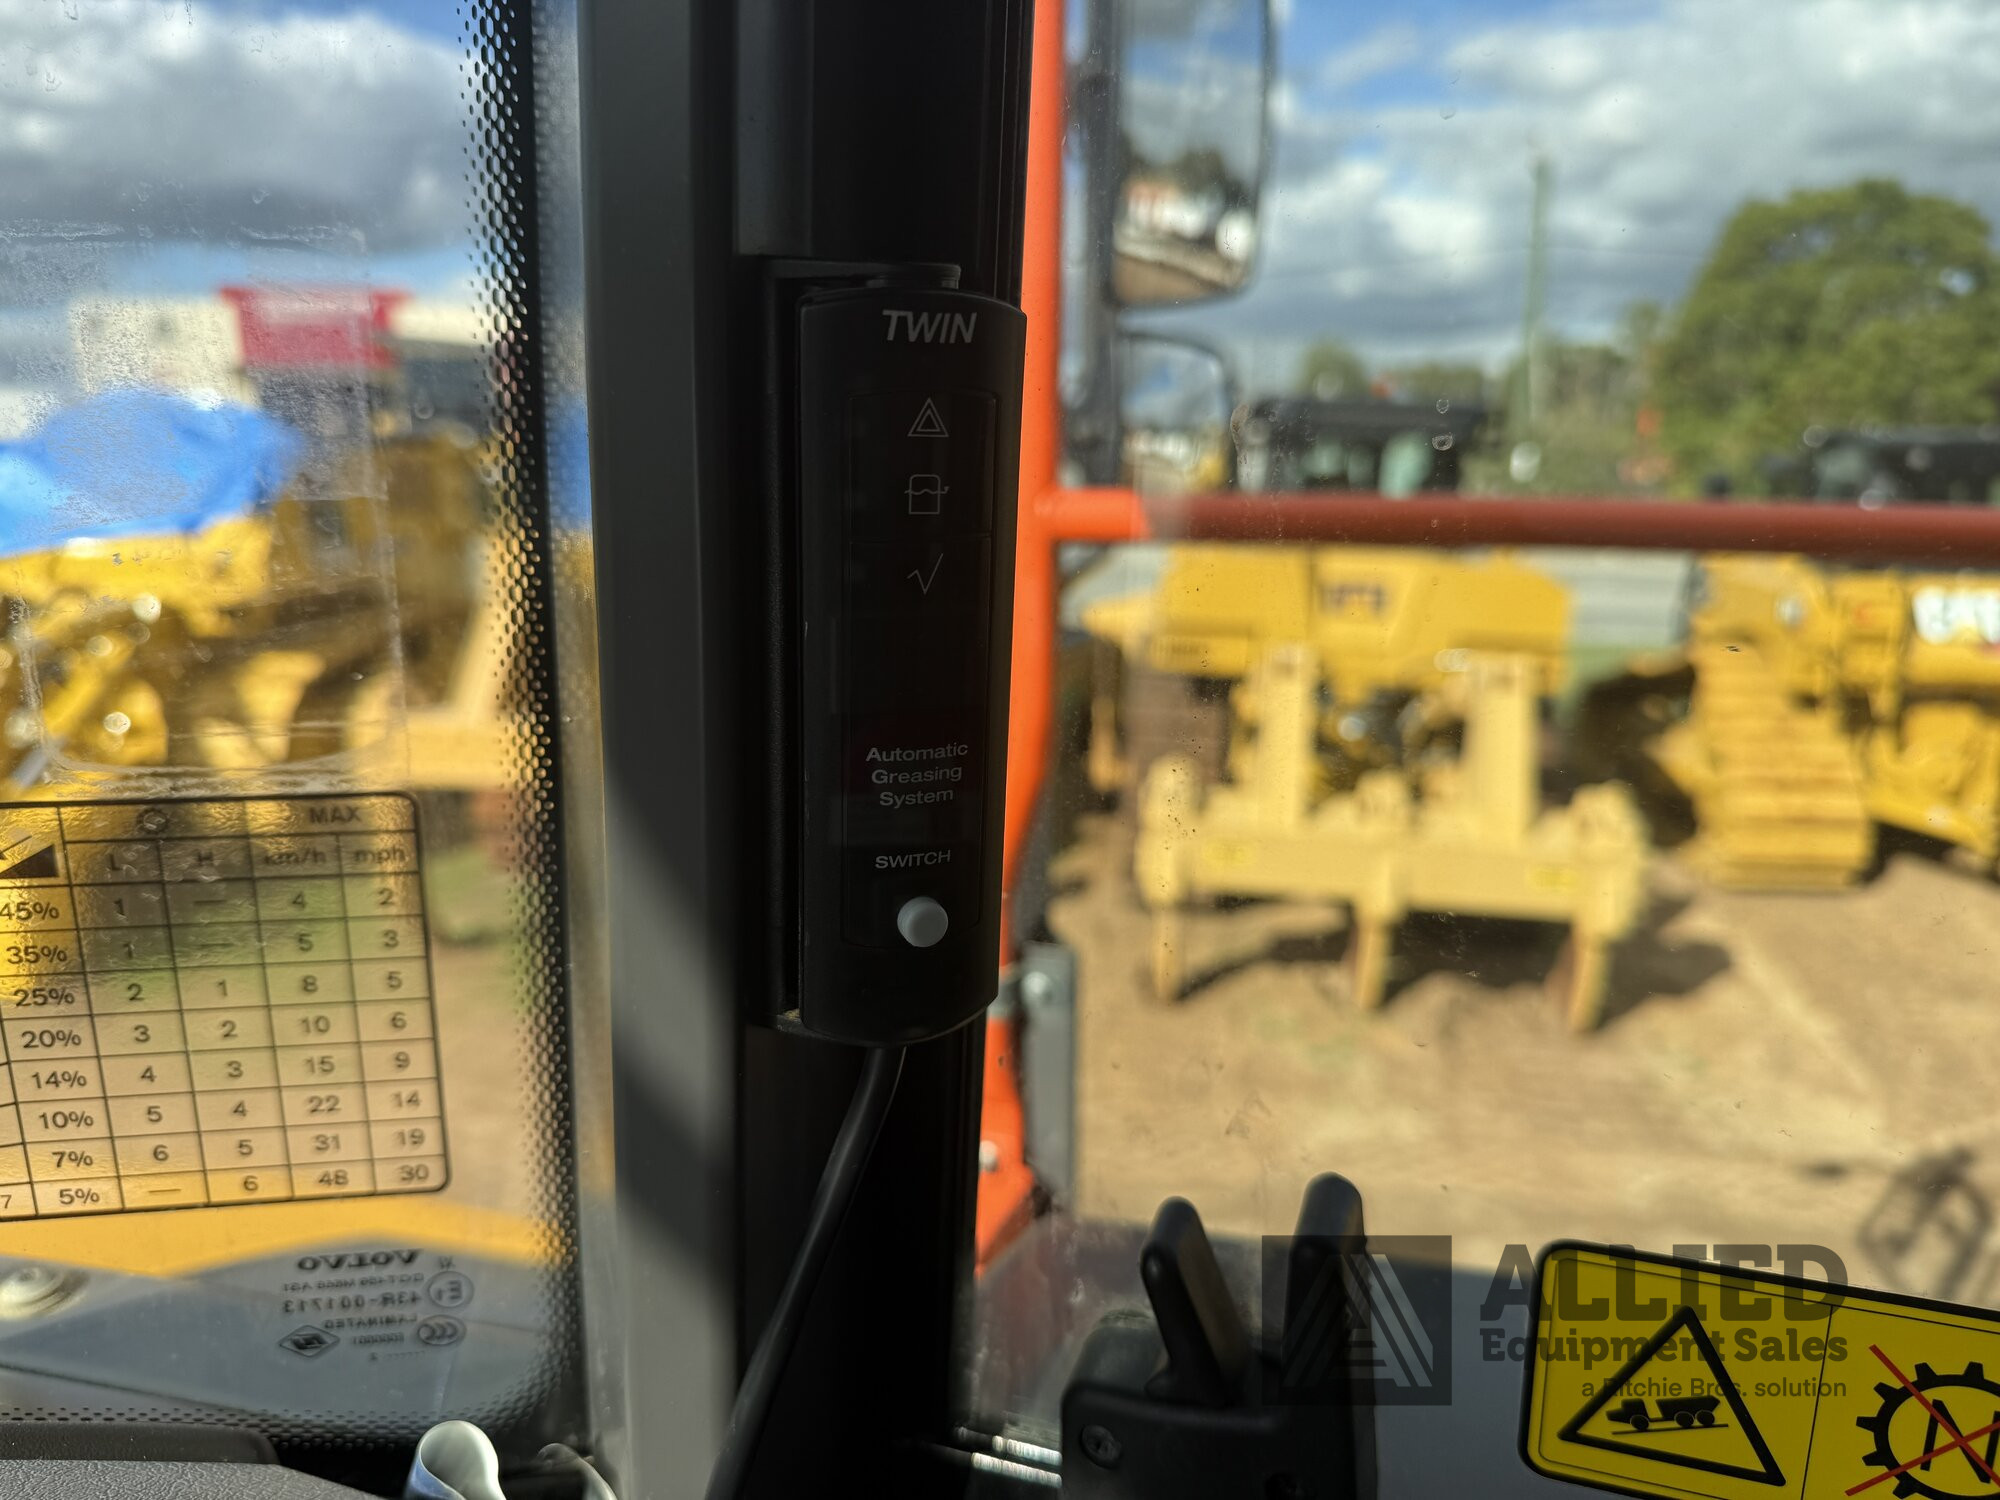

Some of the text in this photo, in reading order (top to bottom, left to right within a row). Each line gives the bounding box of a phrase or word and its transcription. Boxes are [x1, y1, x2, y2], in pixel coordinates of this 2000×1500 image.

[882, 309, 977, 344] TWIN
[866, 742, 969, 762] Automatic
[871, 766, 963, 784] Greasing
[309, 806, 361, 823] MAX
[880, 789, 954, 809] System
[264, 848, 327, 865] km/h
[355, 845, 406, 864] mph
[875, 850, 951, 869] SWITCH
[0, 888, 394, 920] 45% 1 4 2
[6, 930, 399, 965] 35% 1 5 3
[13, 971, 402, 1007] 25% 2 1 8 5
[21, 1011, 407, 1048] 20% 3 2 10 6
[31, 1052, 410, 1089] 14% 4 3 15 9
[39, 1090, 421, 1129] 10% 5 4 22 14
[52, 1128, 425, 1168] 7% 6 5 31 19
[59, 1188, 100, 1205] 5%
[243, 1175, 260, 1191] 6
[318, 1169, 349, 1186] 48
[400, 1164, 430, 1181] 30
